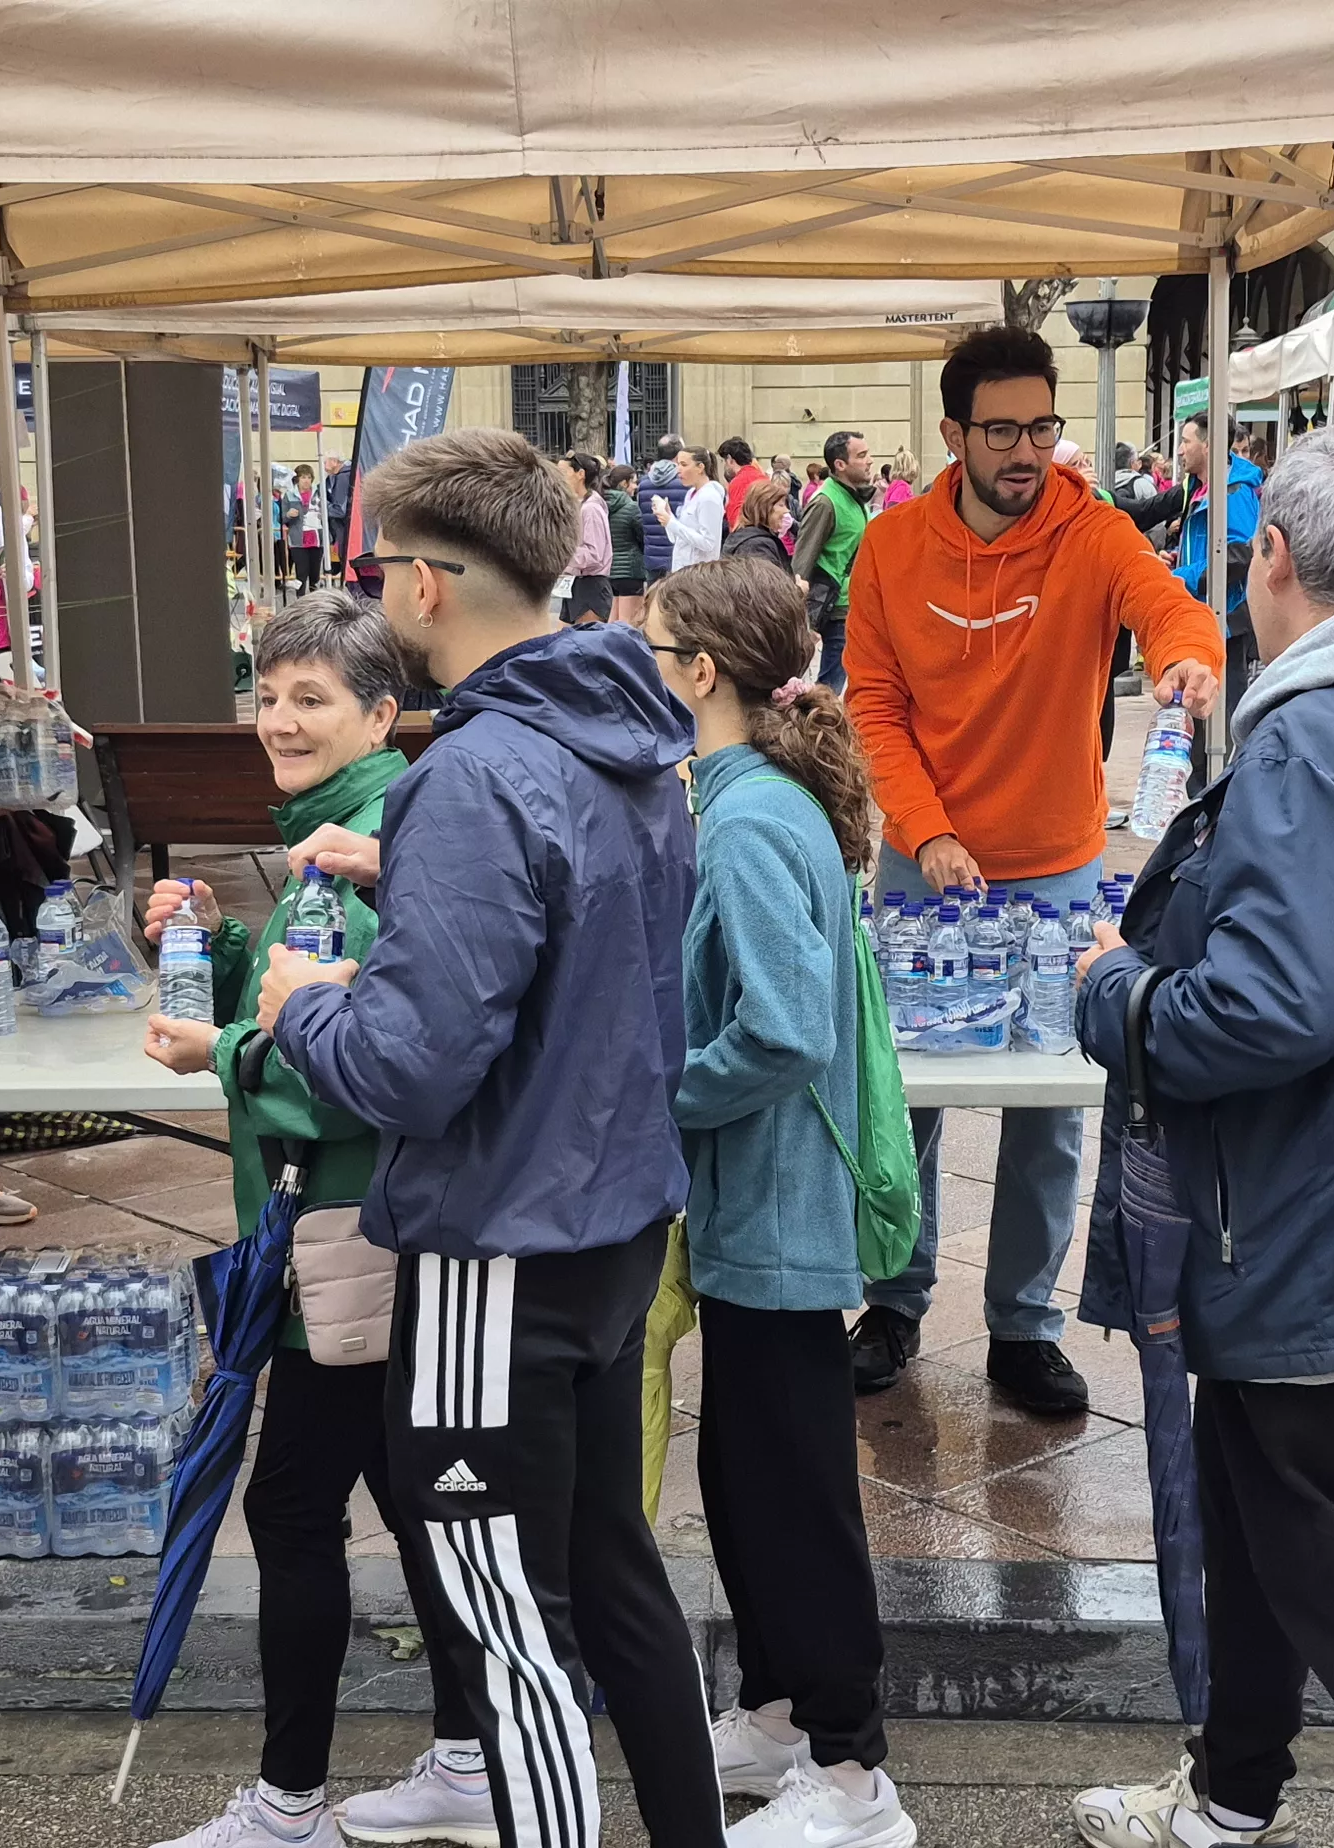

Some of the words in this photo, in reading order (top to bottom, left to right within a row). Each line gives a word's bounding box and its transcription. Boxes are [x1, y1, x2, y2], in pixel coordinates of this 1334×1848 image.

[885, 312, 955, 324] MASTERTENT
[107, 1315, 141, 1325] MINERAL
[95, 1325, 131, 1336] NATURAL
[98, 1452, 134, 1463] MINERAL
[89, 1463, 123, 1473] NATURAL
[433, 1481, 487, 1492] adidas
